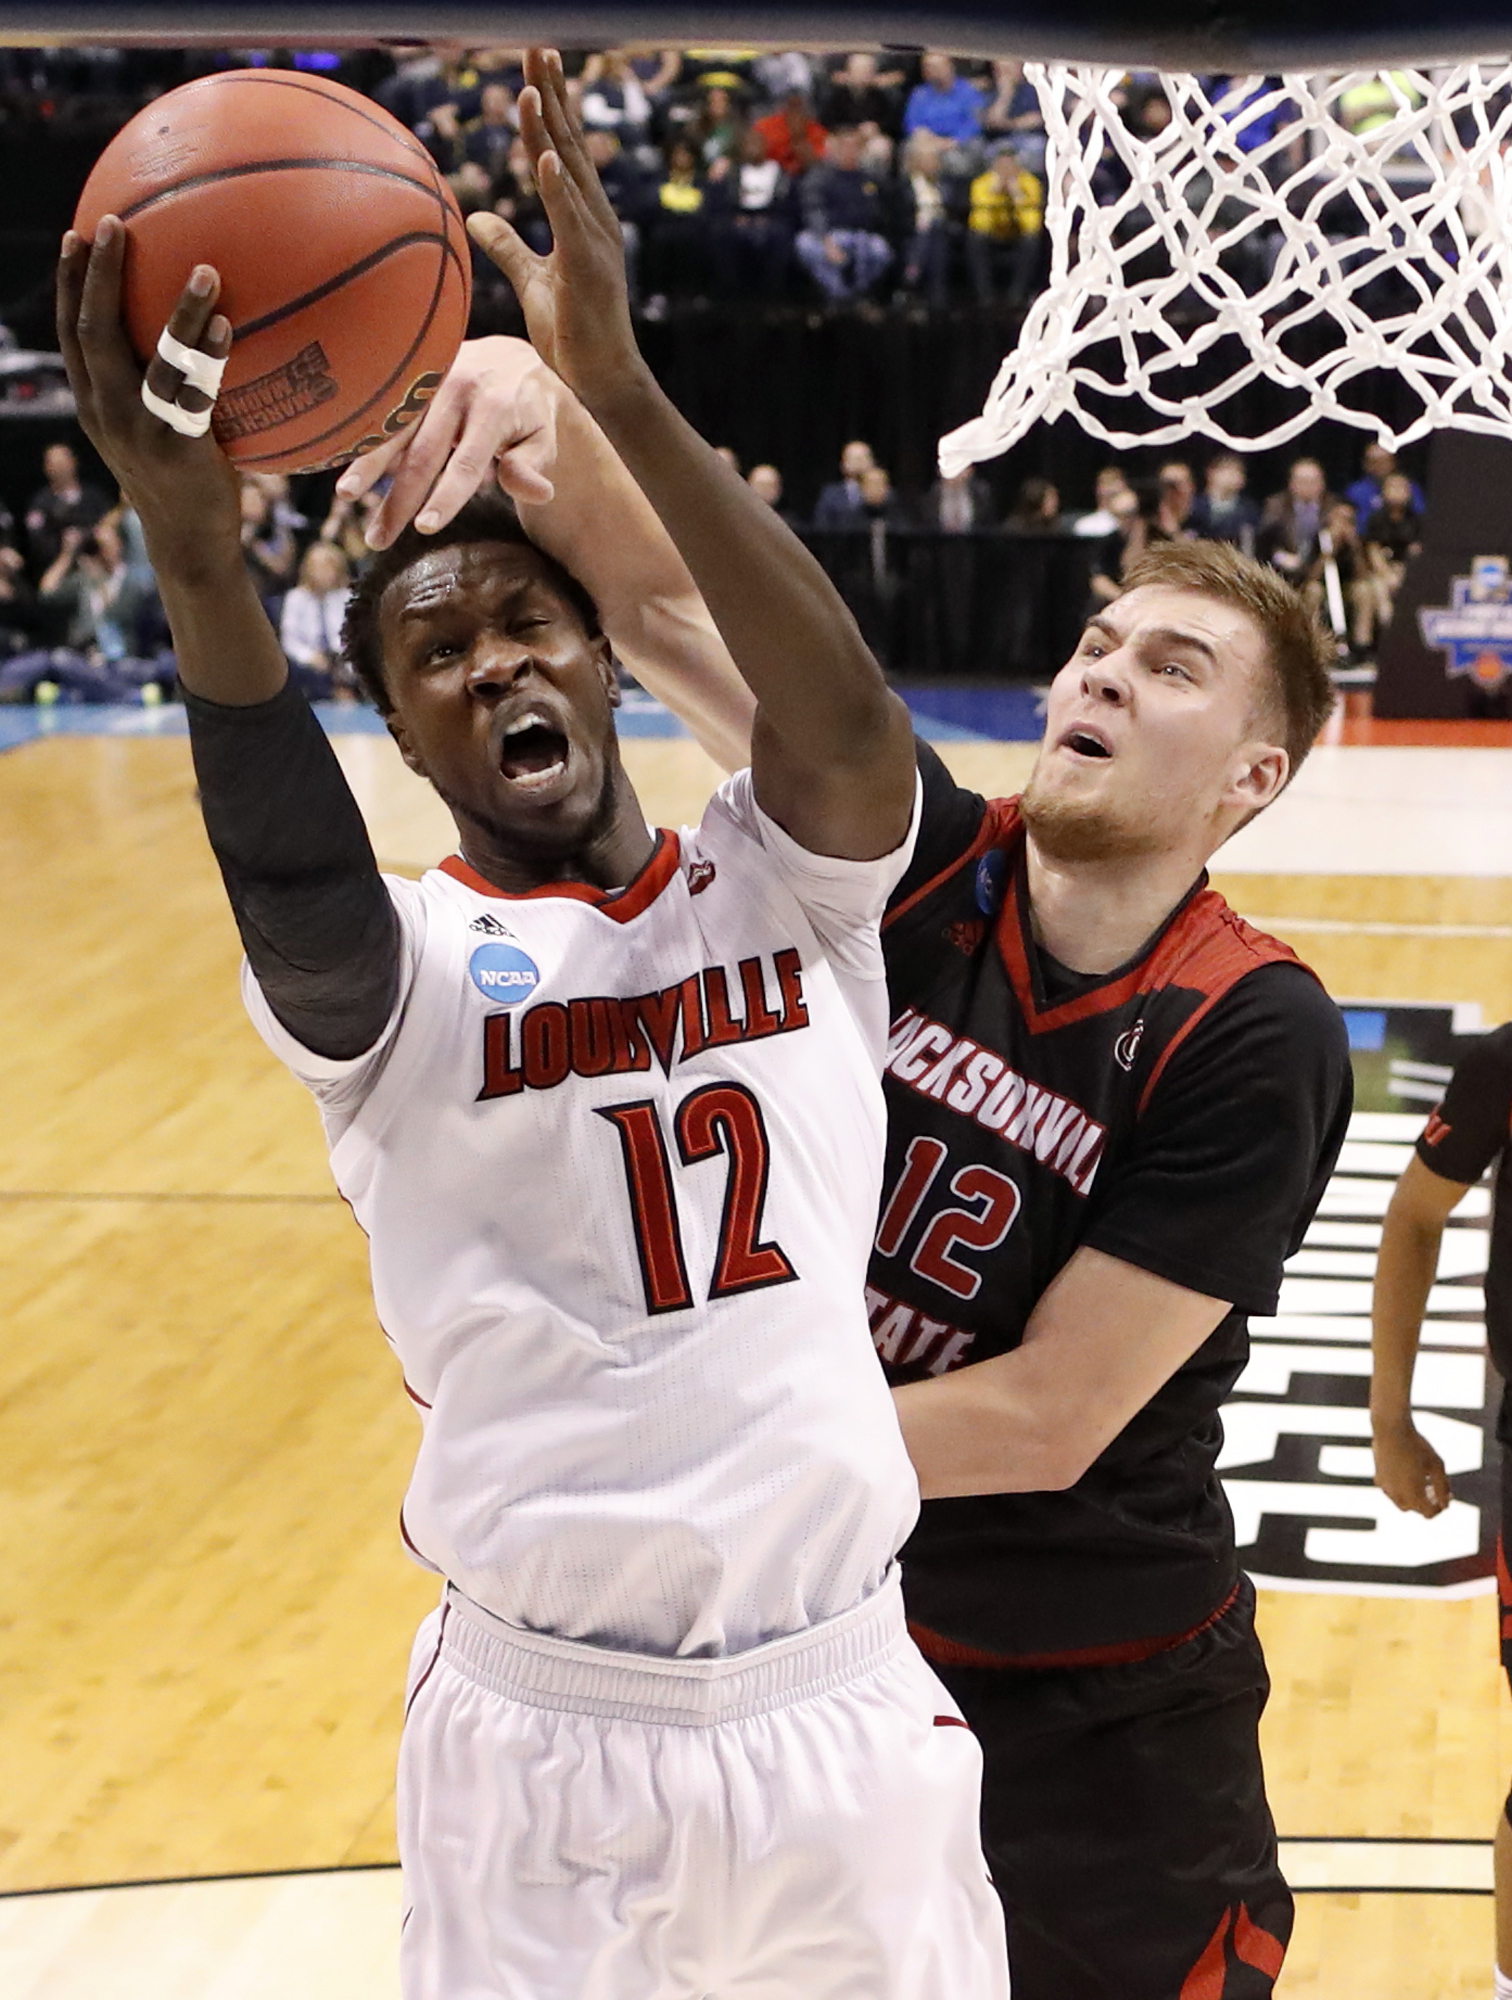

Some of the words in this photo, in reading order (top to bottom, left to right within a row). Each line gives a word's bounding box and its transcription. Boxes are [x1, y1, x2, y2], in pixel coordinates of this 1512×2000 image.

[480, 969, 537, 987] NCAA
[885, 1006, 1104, 1198] ACKSONVIL
[592, 1081, 801, 1317] 12
[874, 1135, 1022, 1300] 12
